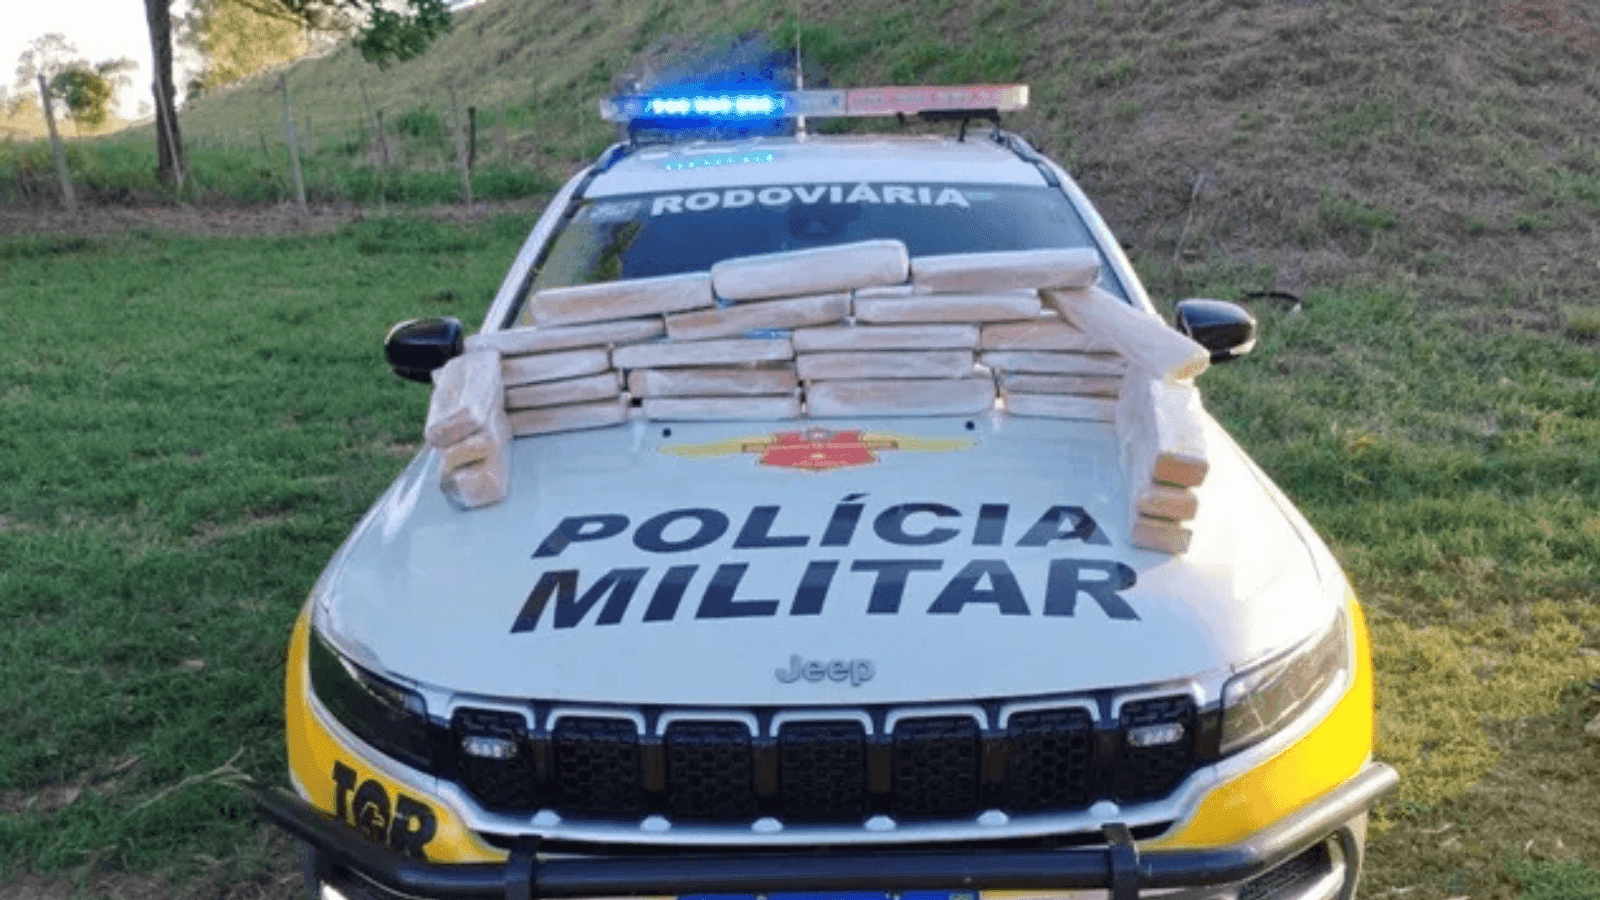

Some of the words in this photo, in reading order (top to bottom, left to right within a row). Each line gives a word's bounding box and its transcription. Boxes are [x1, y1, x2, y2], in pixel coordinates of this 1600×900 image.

[650, 182, 970, 215] RODOVIÁRIA
[531, 493, 1112, 558] POLÍCIA
[509, 559, 1141, 634] MILITAR
[774, 654, 876, 687] Jeep
